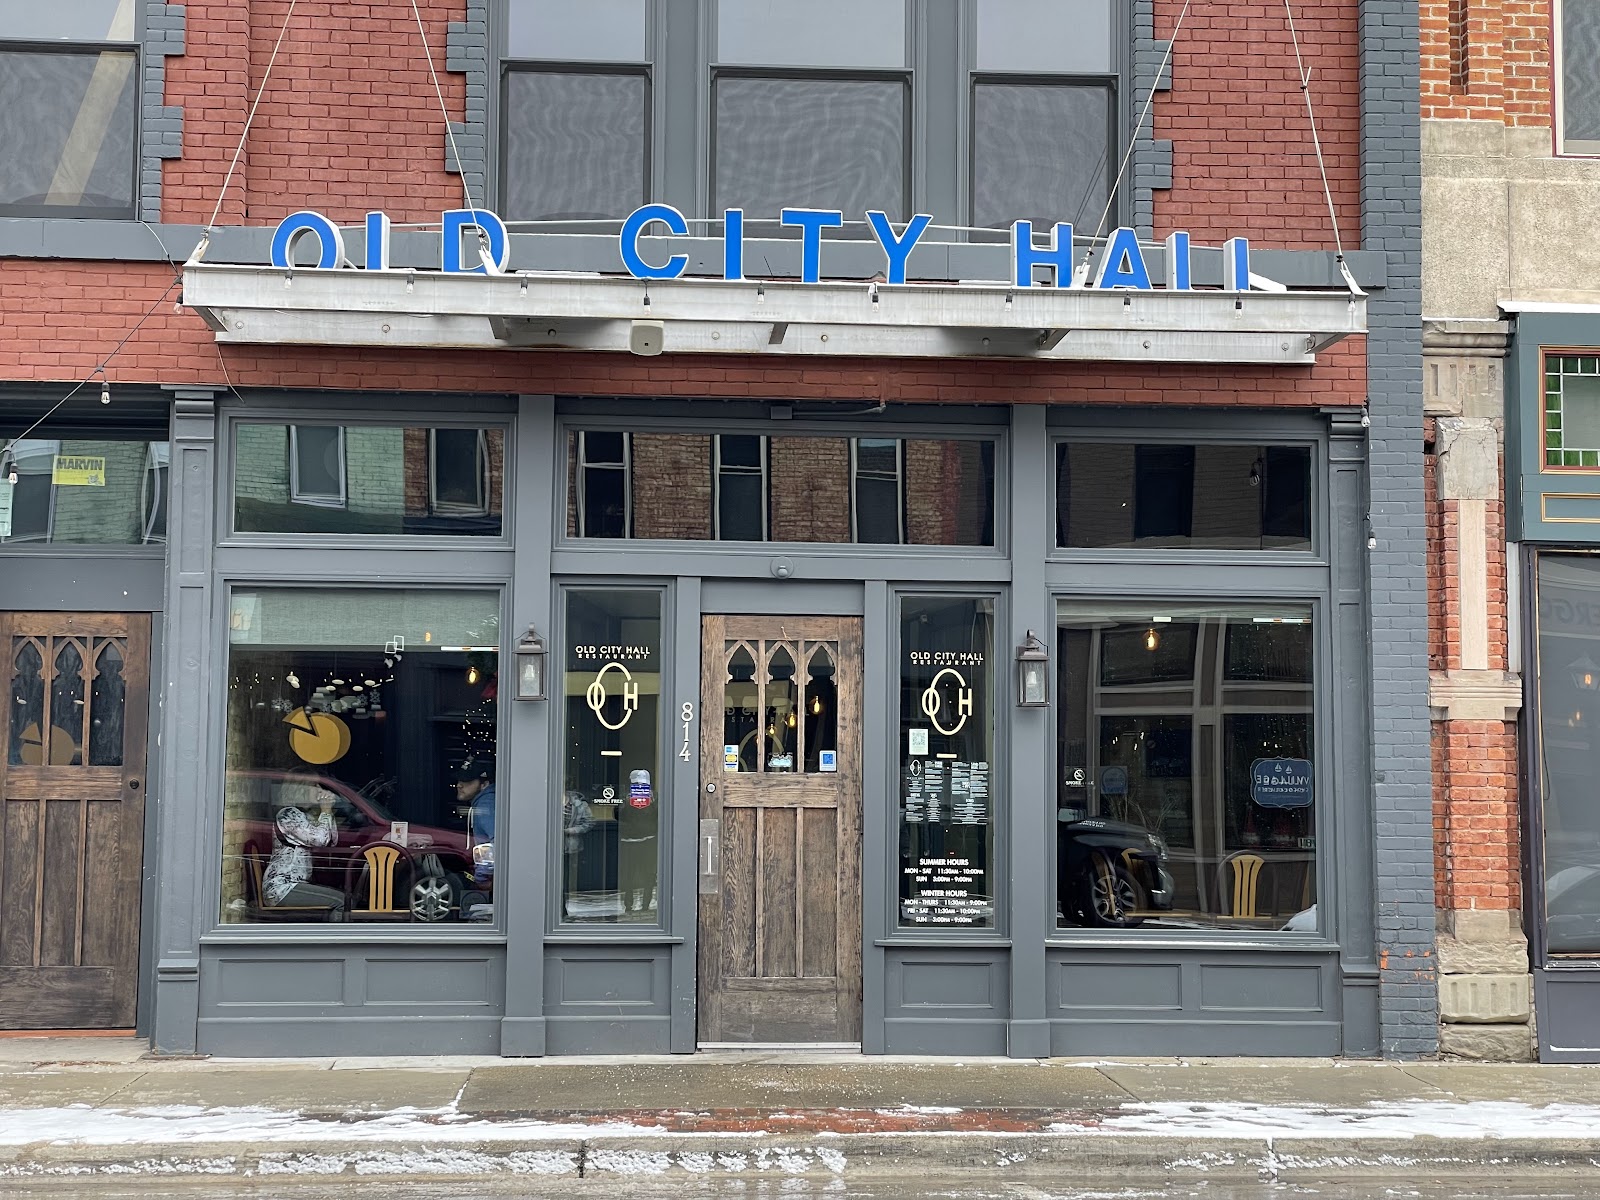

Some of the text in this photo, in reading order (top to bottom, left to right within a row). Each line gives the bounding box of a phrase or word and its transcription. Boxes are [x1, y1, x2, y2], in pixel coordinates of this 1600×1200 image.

[270, 203, 1250, 291] OLD CITY HALL
[57, 457, 103, 471] MARVIN
[575, 645, 651, 655] OLD CITY HALL
[910, 651, 984, 661] OLD CITY HALL
[919, 858, 969, 866] SUMMER HOURS
[920, 889, 945, 897] WINTER
